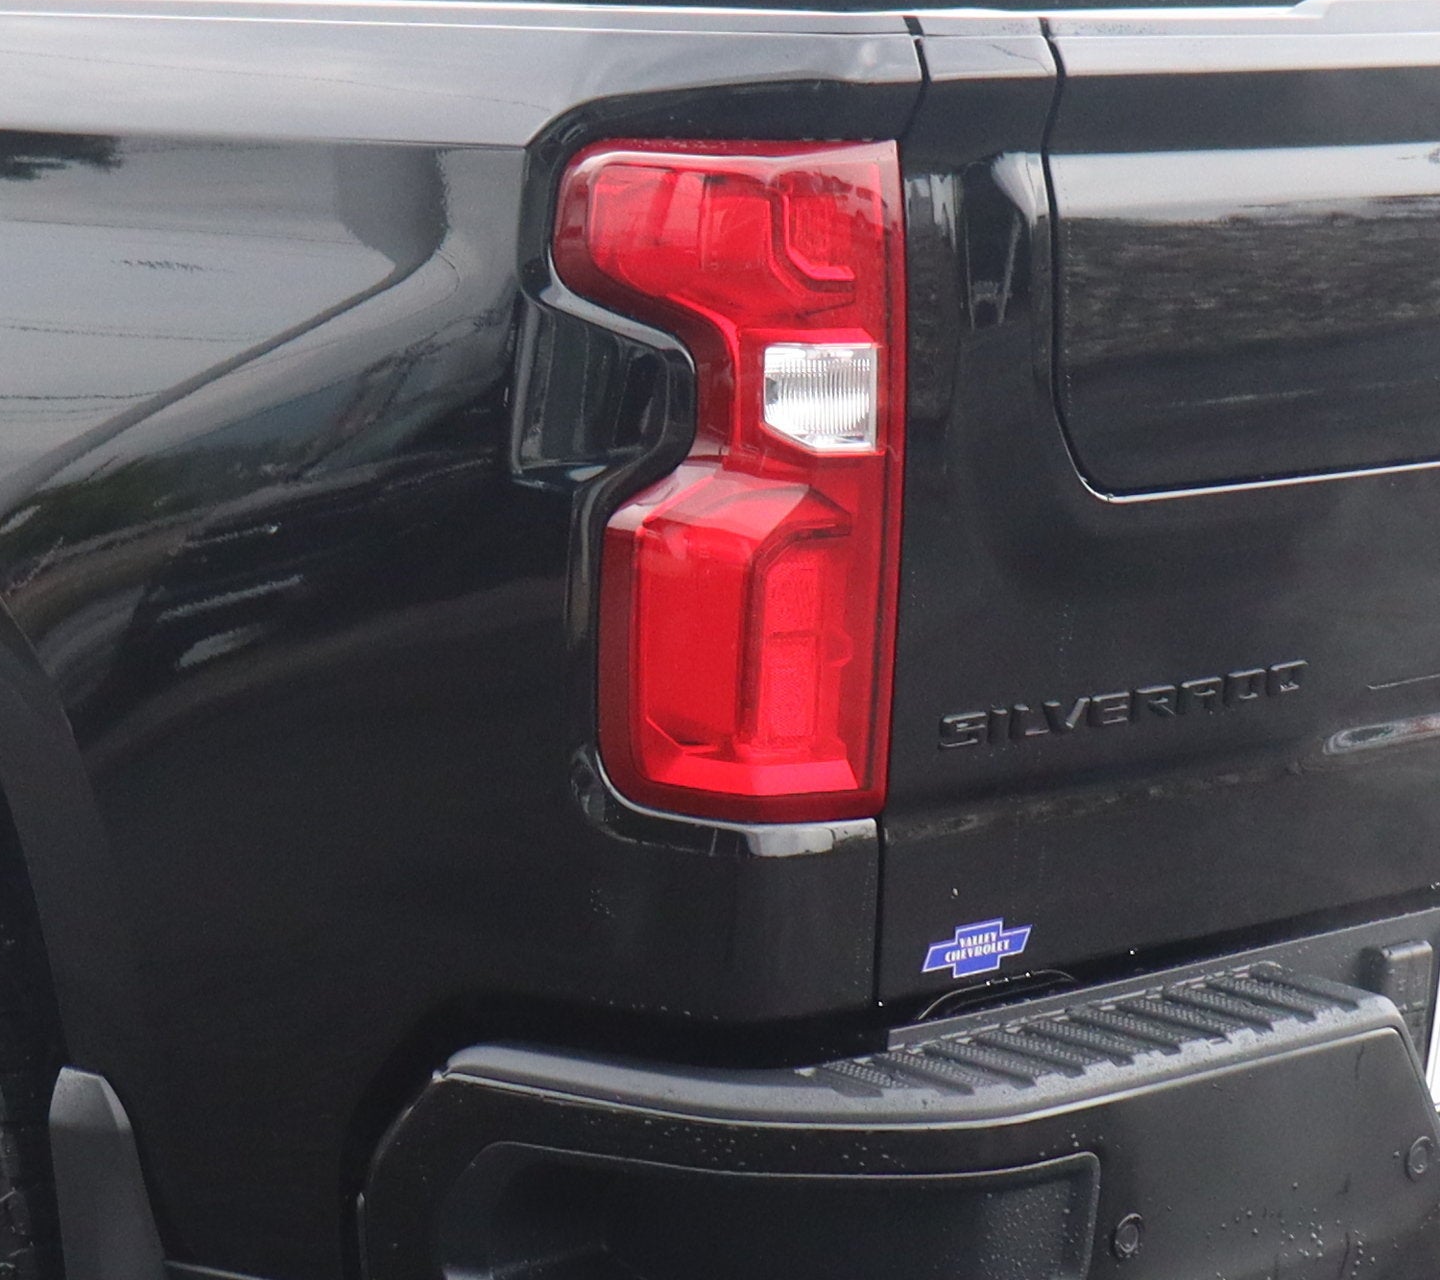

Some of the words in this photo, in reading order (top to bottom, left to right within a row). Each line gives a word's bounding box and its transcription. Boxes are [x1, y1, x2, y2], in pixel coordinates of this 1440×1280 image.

[937, 658, 1310, 750] SILVERADO
[944, 939, 1011, 963] CHEVROLET
[959, 931, 998, 948] VALLEY
